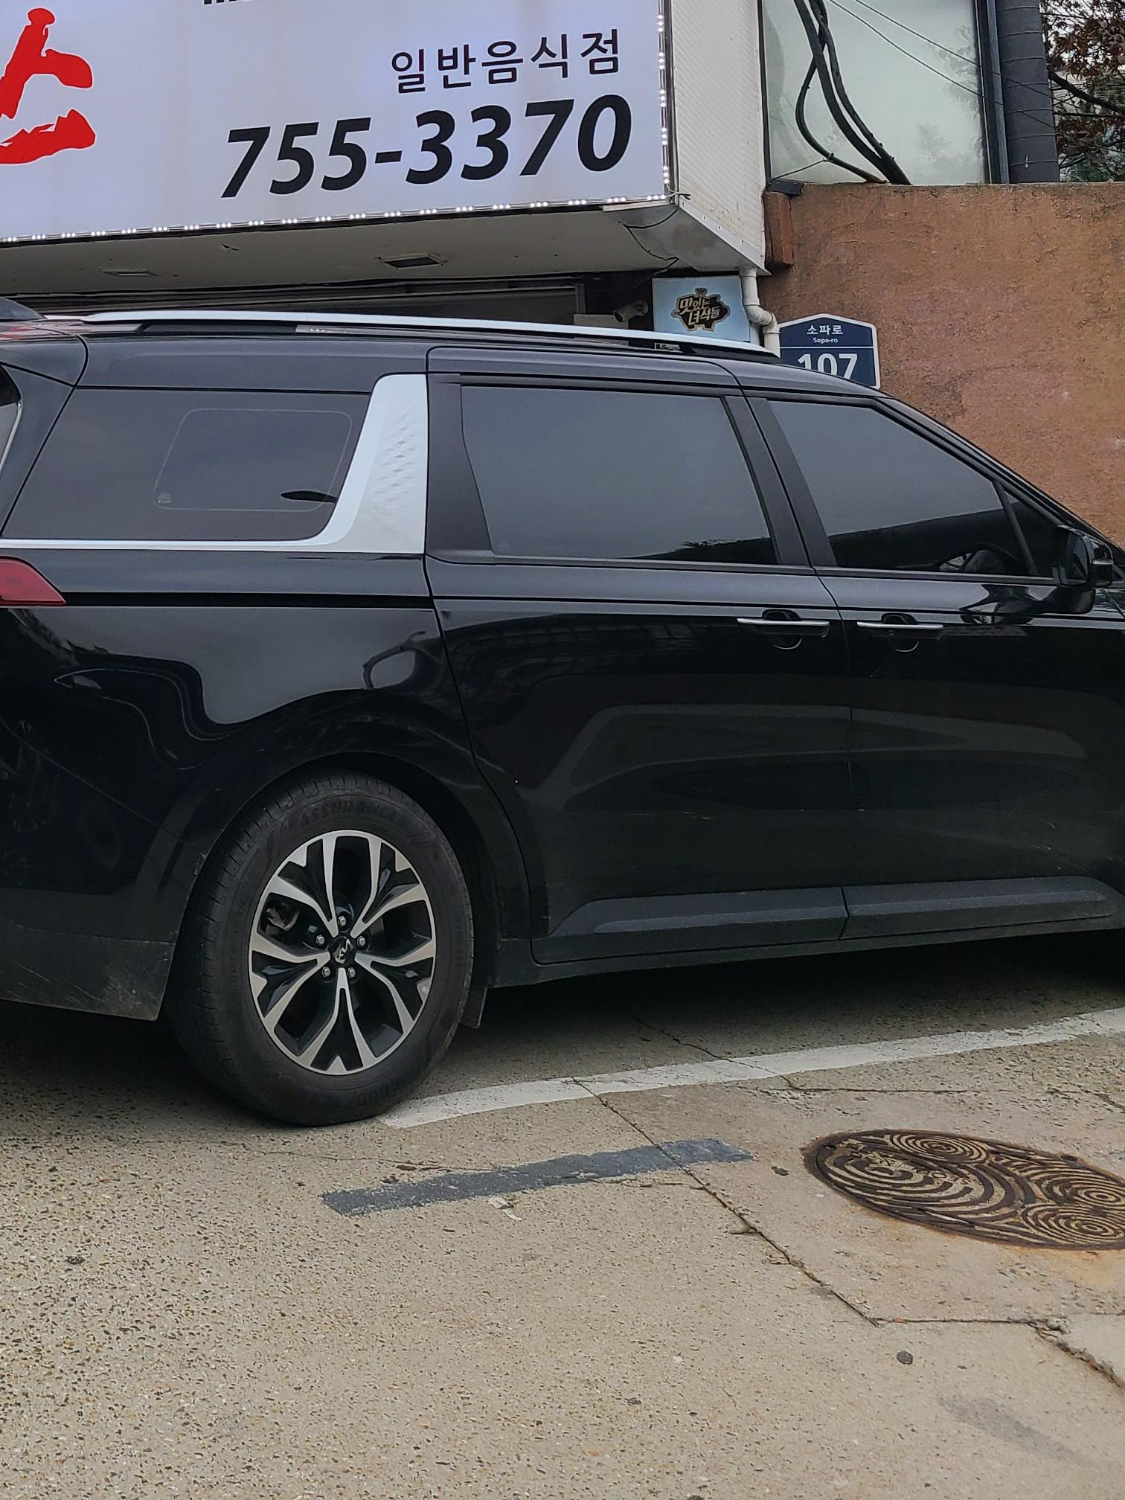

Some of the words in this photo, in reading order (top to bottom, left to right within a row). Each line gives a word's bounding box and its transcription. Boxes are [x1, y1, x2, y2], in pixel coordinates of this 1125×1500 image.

[390, 28, 621, 95] 일반음식점
[220, 94, 633, 199] 755-3370
[679, 297, 710, 315] 맛있는
[687, 305, 721, 326] 녀석들
[806, 324, 844, 336] 소파로
[812, 337, 839, 345] Sopa-ro
[797, 352, 858, 380] 107
